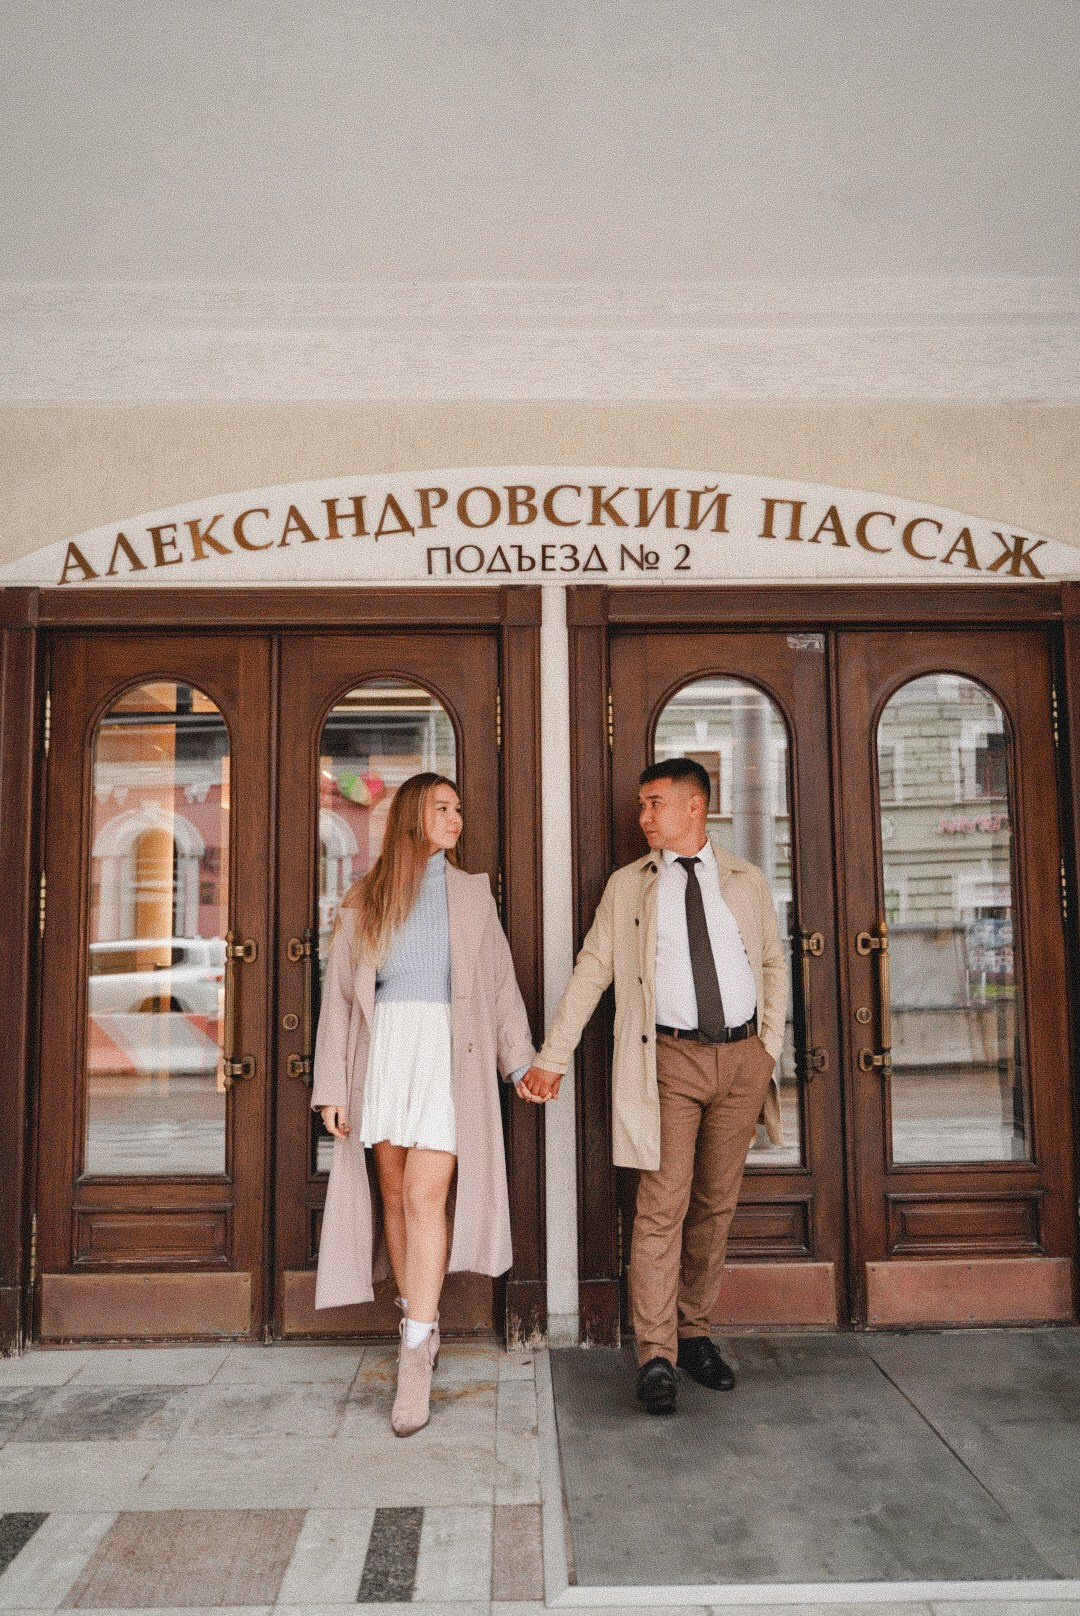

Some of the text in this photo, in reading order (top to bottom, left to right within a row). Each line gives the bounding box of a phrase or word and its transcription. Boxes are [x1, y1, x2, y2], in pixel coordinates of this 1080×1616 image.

[57, 484, 1048, 585] АЛЕКСАНДРОВСКИЙ ПАССАЖ
[426, 543, 691, 575] ПОДЪЕЗД № 2
